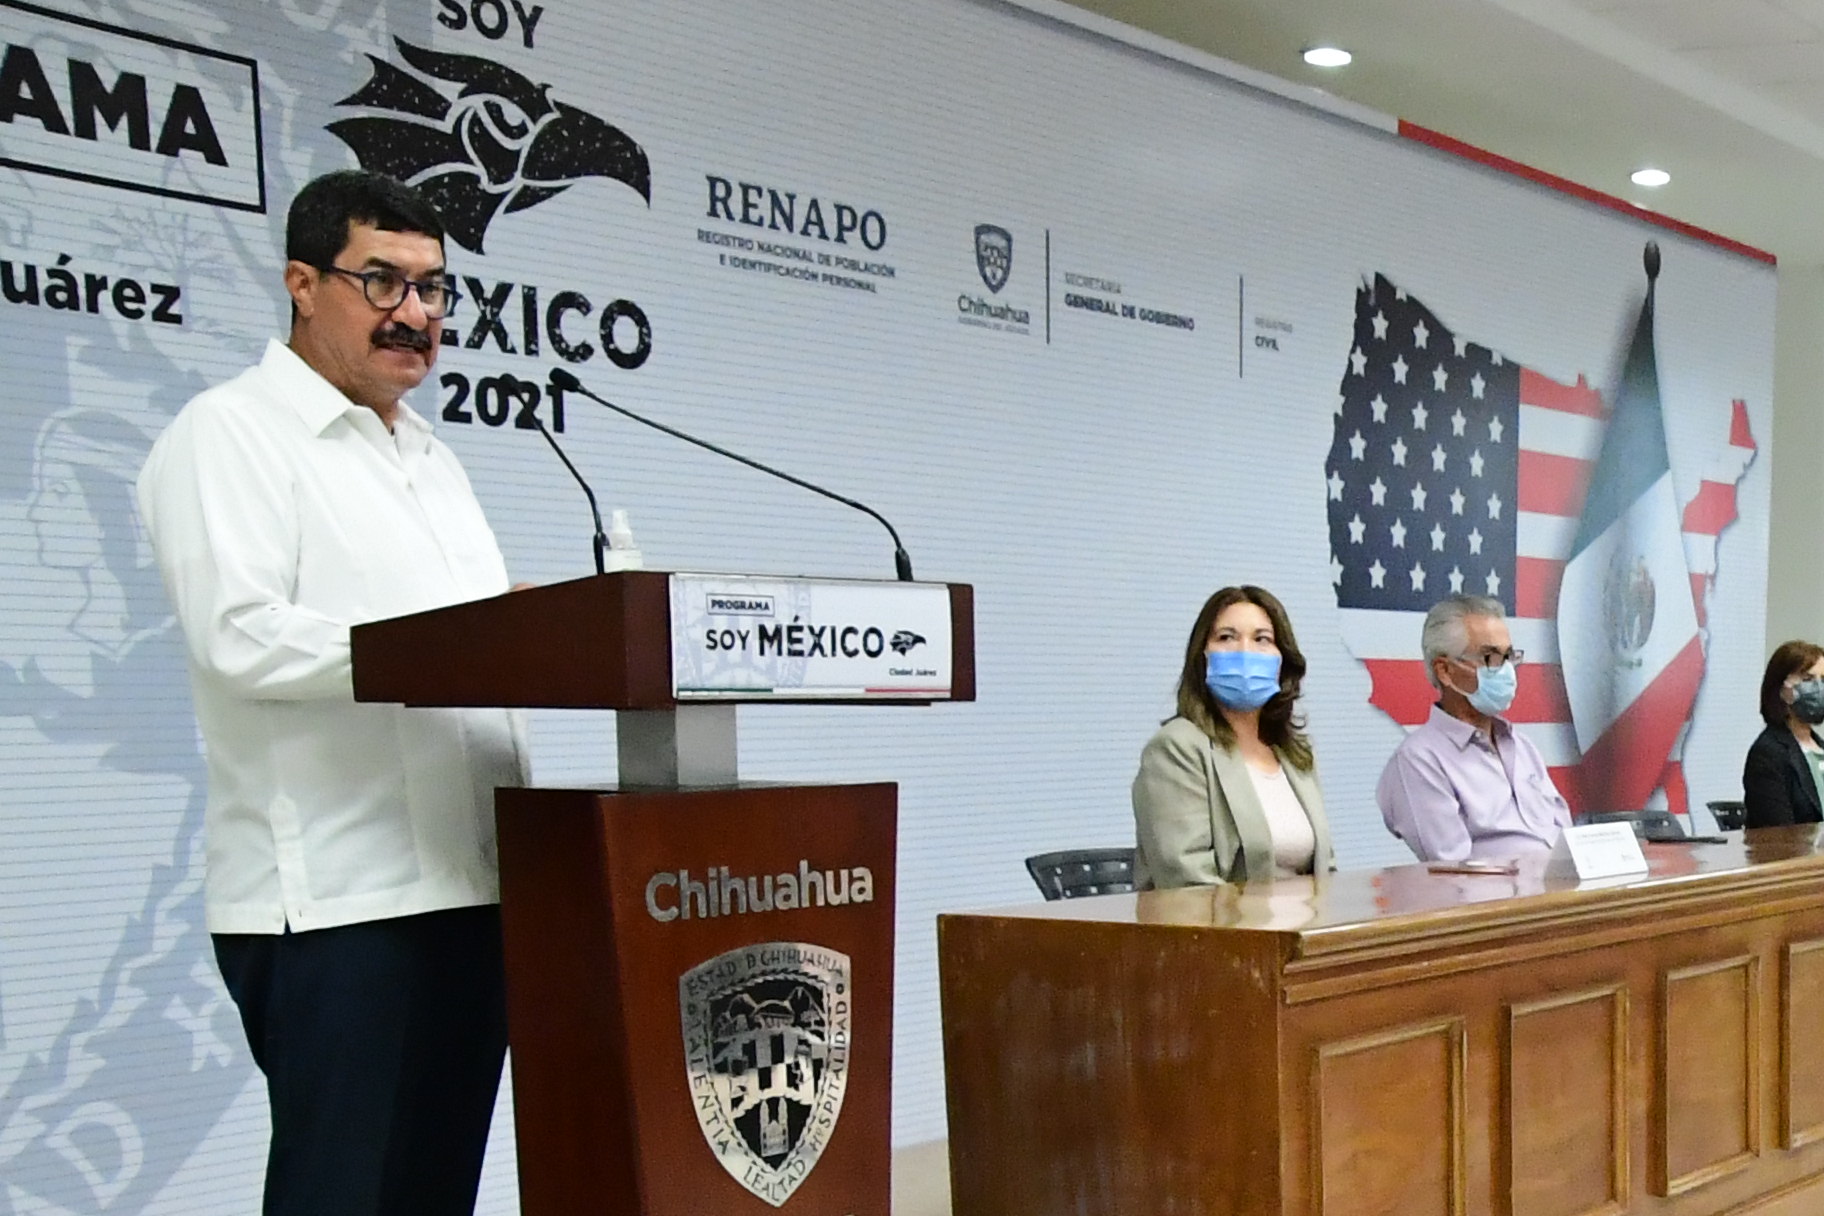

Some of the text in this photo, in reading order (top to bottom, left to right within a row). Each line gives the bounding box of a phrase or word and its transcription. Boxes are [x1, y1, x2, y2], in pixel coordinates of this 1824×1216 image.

[436, 0, 545, 49] SOY
[0, 43, 230, 168] AMA
[705, 174, 887, 251] RENAPO
[697, 228, 896, 278] REGISTRO NACIONAL DE POBLACIÓN
[719, 253, 877, 294] E IDENTIFICACIÓN PERSONAL
[0, 252, 183, 325] uárez
[958, 293, 1030, 325] Chihuahua
[1064, 292, 1195, 331] GENERAL DE GOBIERNO
[440, 371, 566, 434] 2021
[710, 598, 771, 612] PROGRAMA
[705, 615, 885, 659] SOY MÉXICO
[644, 859, 875, 923] Chihuahua
[743, 1159, 806, 1201] LEALTAD
